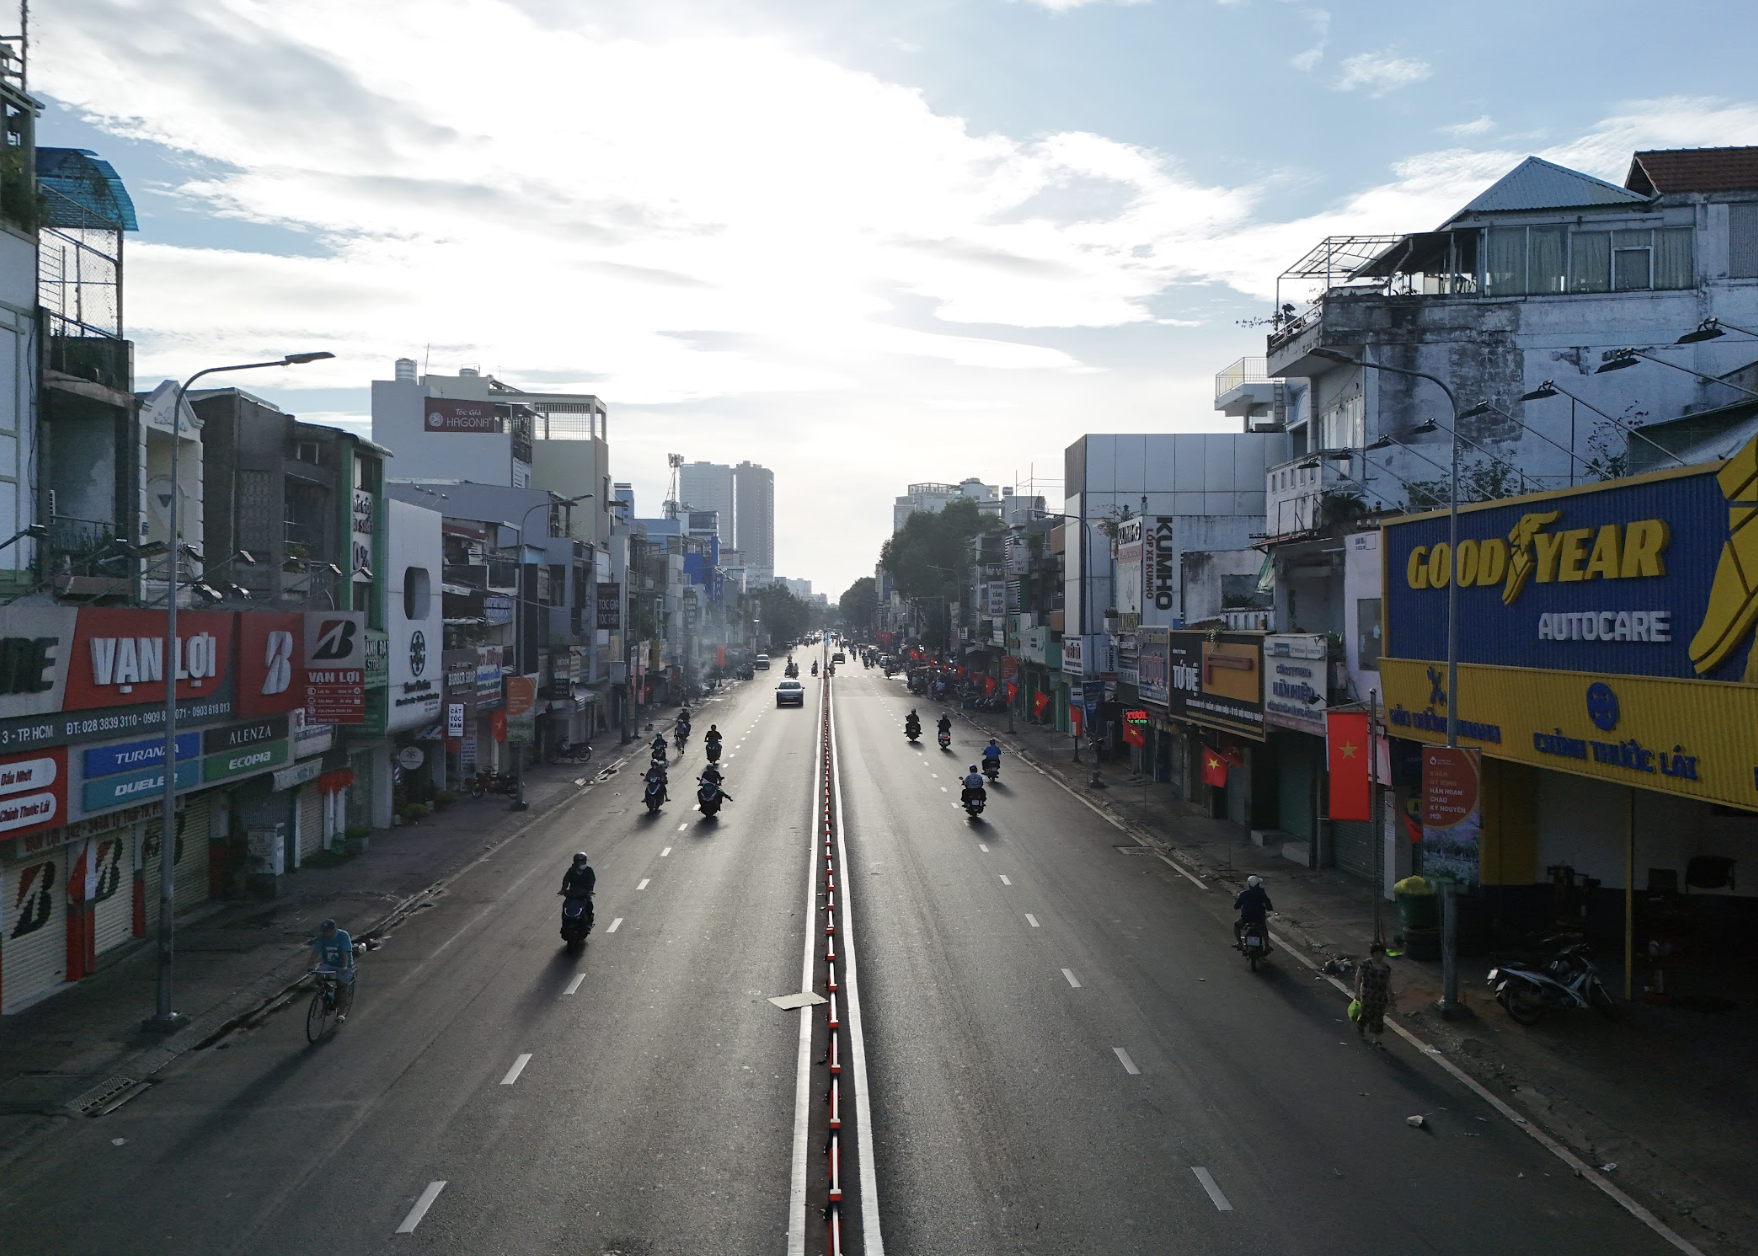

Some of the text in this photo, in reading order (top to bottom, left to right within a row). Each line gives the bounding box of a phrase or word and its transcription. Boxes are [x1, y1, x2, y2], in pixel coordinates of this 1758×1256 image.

[447, 418, 490, 428] HAGONA
[1146, 550, 1154, 562] XE
[1156, 517, 1173, 610] KUMHO
[1407, 518, 1669, 590] GOODYEAR
[1146, 564, 1154, 600] KUMHO
[1538, 610, 1672, 642] AUTOCARE
[90, 631, 216, 694] VẠN LỢI
[308, 670, 360, 685] VẠN LỢI
[2, 730, 9, 743] 3
[32, 725, 54, 740] HCM
[66, 722, 81, 735] ĐT:
[82, 719, 97, 733] 028
[99, 716, 119, 731] 3839
[120, 713, 137, 728] 3110
[143, 711, 160, 724] 0909
[192, 706, 207, 717] 0903
[220, 703, 231, 713] 013
[229, 725, 272, 745] ALENZA
[1533, 728, 1587, 762] CHỈNH
[1660, 745, 1699, 782] LÁI
[1444, 789, 1463, 797] HOAN
